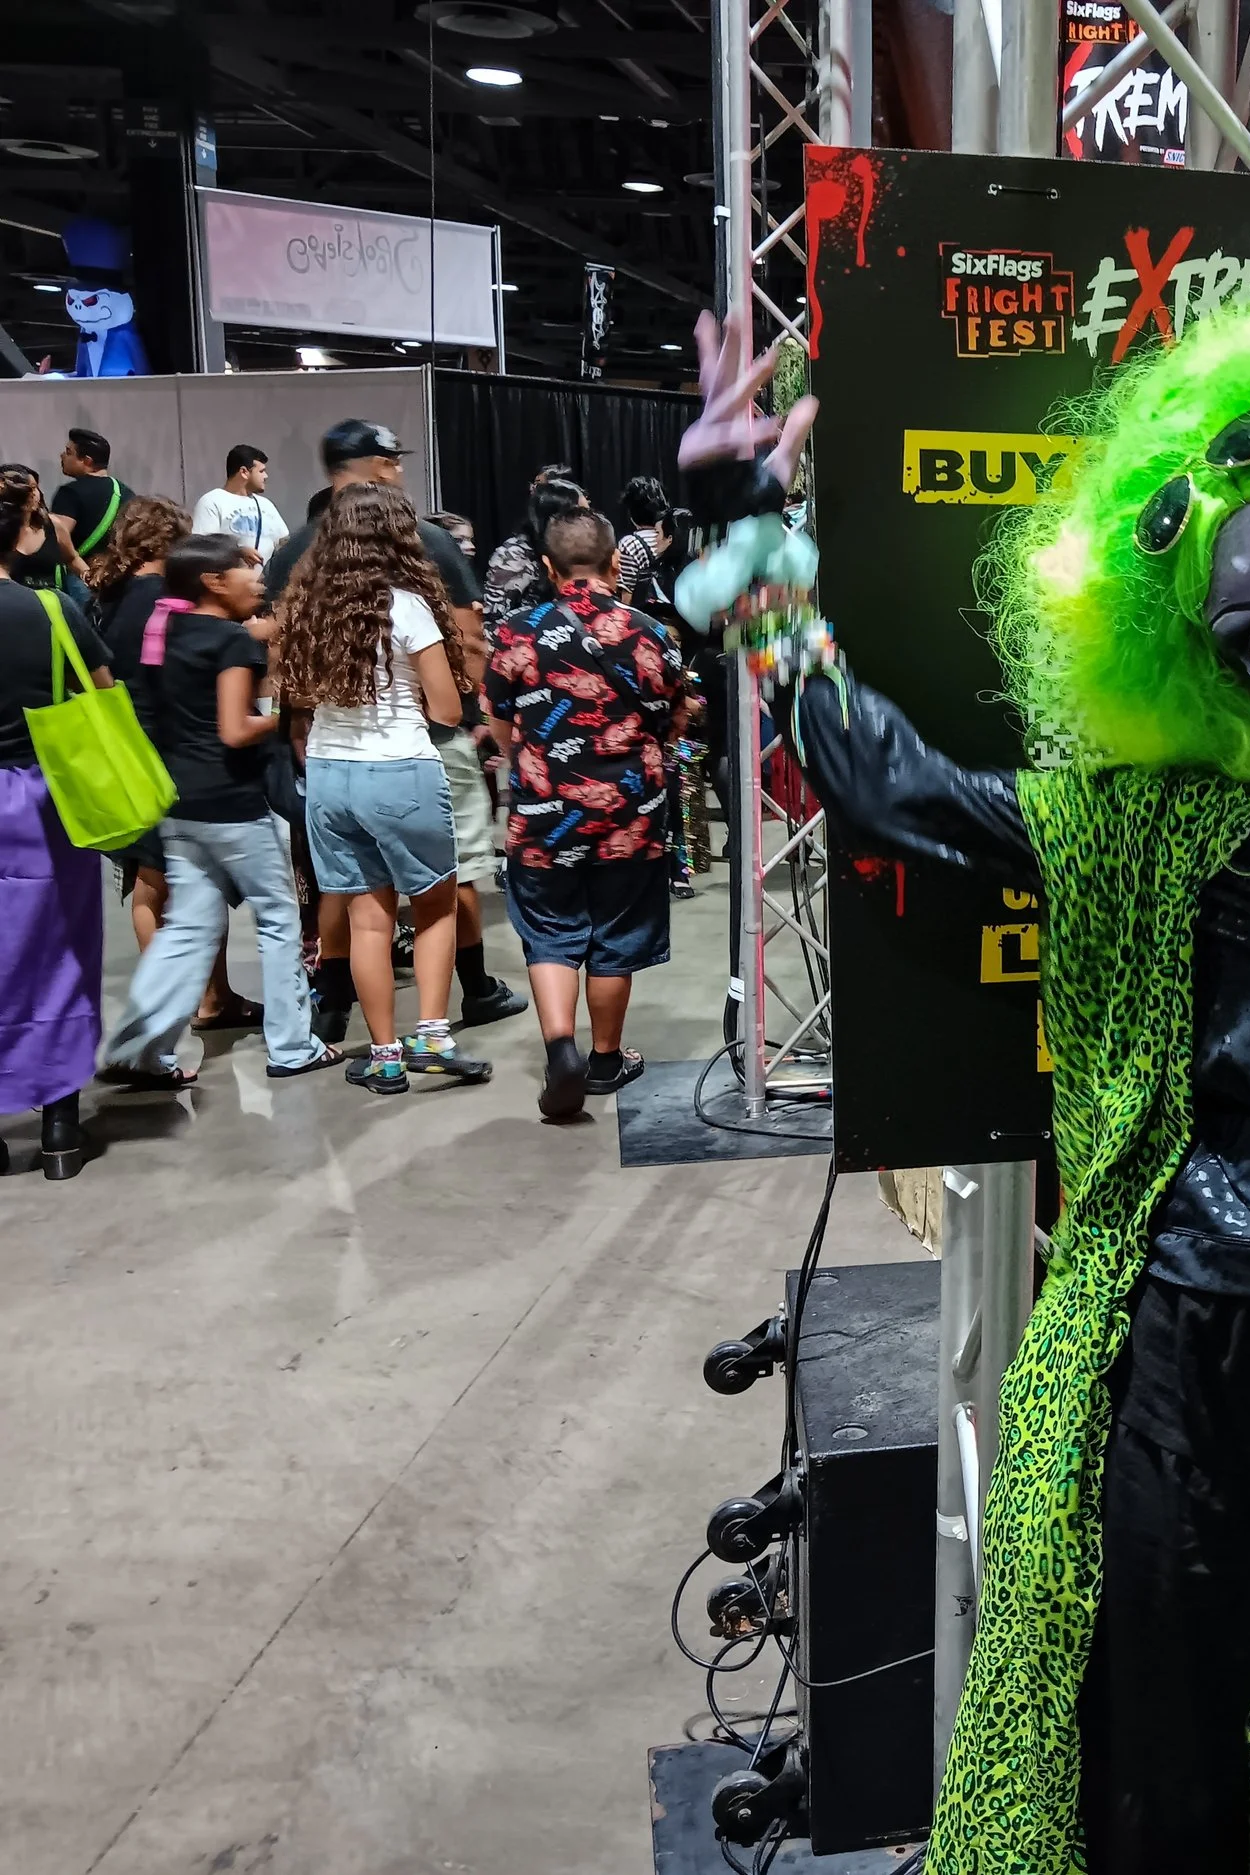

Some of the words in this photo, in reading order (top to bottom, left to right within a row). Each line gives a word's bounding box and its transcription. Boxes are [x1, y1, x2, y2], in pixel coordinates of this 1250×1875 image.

[1066, 0, 1121, 21] SixFlags
[1068, 21, 1123, 41] RIGHT
[951, 252, 1044, 282] SixFlags
[946, 278, 1069, 315] FRIGHT
[967, 317, 1056, 350] FEST
[919, 448, 1070, 494] BUY
